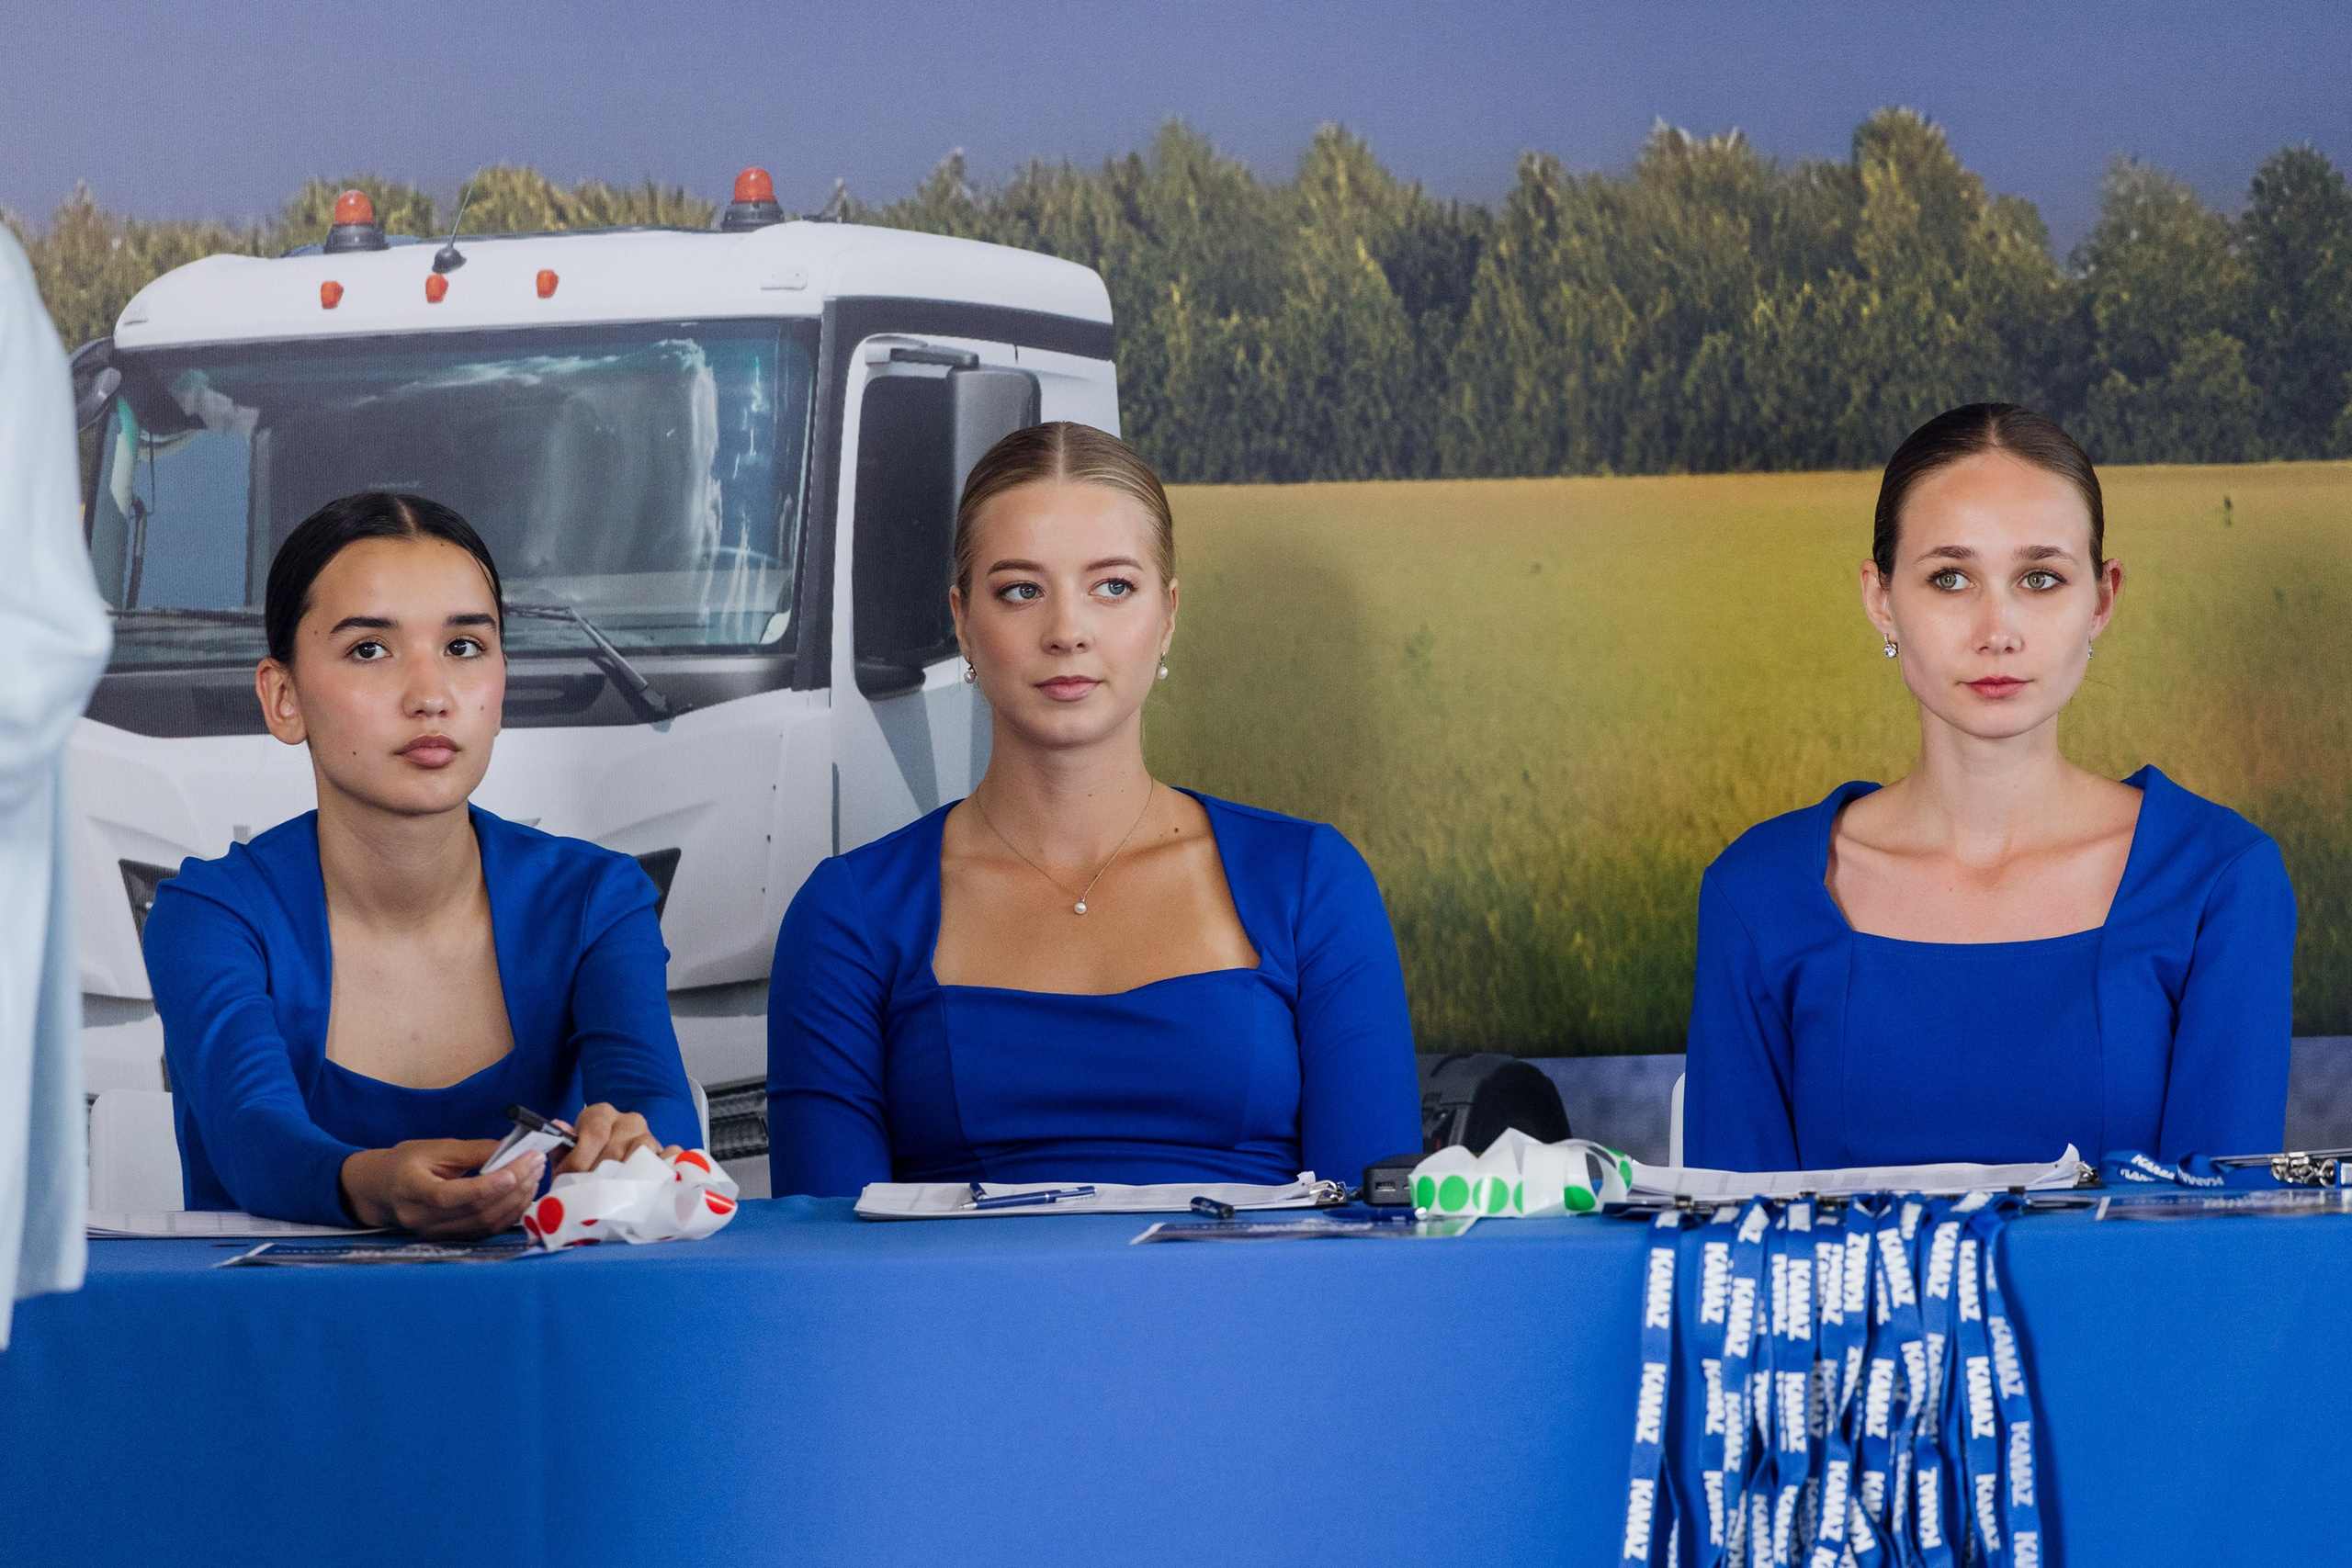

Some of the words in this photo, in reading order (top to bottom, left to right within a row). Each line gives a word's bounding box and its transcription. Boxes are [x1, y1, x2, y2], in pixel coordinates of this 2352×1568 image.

[1645, 1247, 1675, 1329] KAMAZ
[1701, 1242, 1729, 1324] KAMAZ
[1787, 1258, 1812, 1341] KAMAZ
[1843, 1232, 1871, 1312] KAMAZ
[1877, 1227, 1916, 1308] KAMAZ
[1926, 1221, 1961, 1300] KAMAZ
[1958, 1239, 1982, 1322] KAMAZ
[1724, 1277, 1756, 1359] KAMAZ
[1988, 1315, 2025, 1400] KAMAZ
[1635, 1361, 1667, 1444] KAMAZ
[1702, 1358, 1725, 1436] KAMAZ
[1723, 1392, 1744, 1472] KAMAZ
[1785, 1371, 1807, 1453] KAMAZ
[1866, 1358, 1894, 1439] KAMAZ
[1966, 1356, 1995, 1440] KAMAZ
[1819, 1460, 1849, 1542] KAMAZ
[2009, 1421, 2034, 1508] KAMAZ
[1623, 1477, 1654, 1561] KAMAZ
[1917, 1466, 1942, 1550] KAMAZ
[1975, 1473, 2001, 1554] KAMAZ
